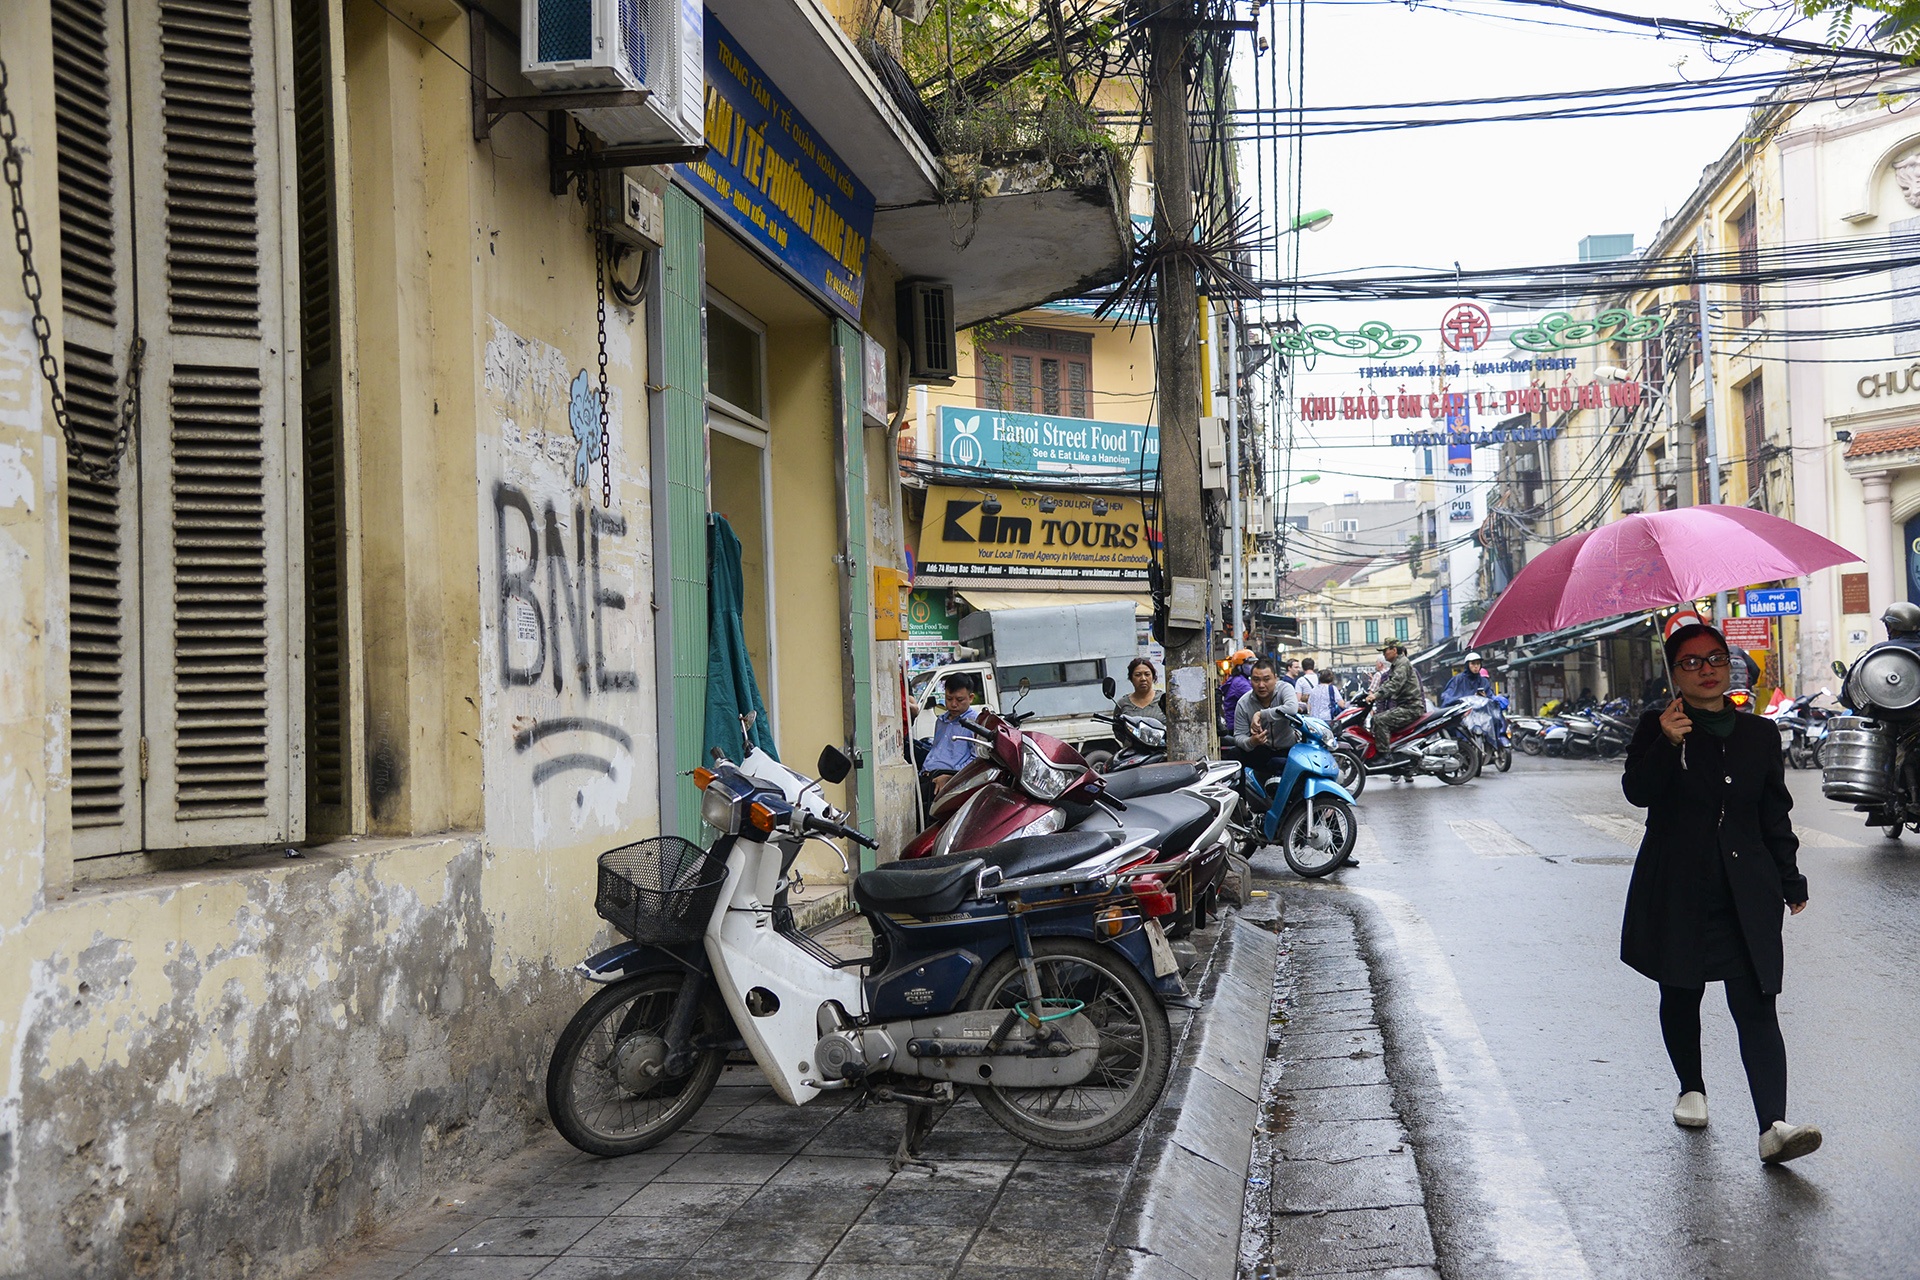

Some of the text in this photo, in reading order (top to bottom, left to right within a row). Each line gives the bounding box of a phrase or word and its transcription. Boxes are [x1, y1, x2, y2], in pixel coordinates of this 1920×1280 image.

[719, 40, 748, 86] TRUNG
[751, 76, 770, 111] TÂM
[772, 100, 778, 118] Y
[780, 109, 792, 133] TẾ
[793, 124, 815, 160] QUẬN
[704, 79, 866, 282] ẠM Y TẾ PHƯỜNG HÀNG BẠC
[716, 174, 730, 200] BẠC
[1359, 361, 1397, 378] TUYẾN
[1400, 360, 1424, 377] PHỐ
[1474, 359, 1532, 374] WALKING
[1536, 357, 1577, 371] STREET
[1300, 396, 1336, 422] KHU
[1344, 388, 1379, 420] BẢO
[1385, 384, 1422, 418] TỒN
[1428, 384, 1464, 419] CẤP
[1475, 392, 1483, 415] 1
[1506, 378, 1542, 414] PHỐ
[1547, 372, 1572, 412] CỔ
[1578, 380, 1602, 410] HÀ
[1609, 377, 1640, 413] NỘI
[992, 417, 1159, 454] Hanoi Street Food Tou
[1391, 421, 1557, 446] QUẬN HOÀN KIẾM
[1033, 448, 1047, 458] See
[1050, 450, 1056, 458] &
[1058, 450, 1072, 460] Eat
[1074, 452, 1090, 462] Like
[1099, 454, 1130, 464] Hanoian
[1064, 500, 1074, 508] DU
[1075, 500, 1090, 510] LỊCH
[1452, 501, 1472, 510] PUB
[942, 500, 1139, 549] Kim TOURS
[978, 548, 993, 558] Your
[995, 549, 1014, 559] Local
[1015, 550, 1036, 560] Travel
[1036, 551, 1061, 562] Agency
[1062, 552, 1068, 560] in
[1111, 553, 1116, 561] &
[1118, 553, 1148, 563] Cambodia
[926, 564, 938, 573] Add:
[938, 564, 944, 573] 74
[945, 565, 958, 574] Hang
[959, 565, 969, 573] Bac
[988, 566, 1002, 574] Hanoi
[494, 480, 640, 701] BNE
[1769, 592, 1785, 600] PHỐ
[1750, 601, 1797, 613] HÀNG BẠC
